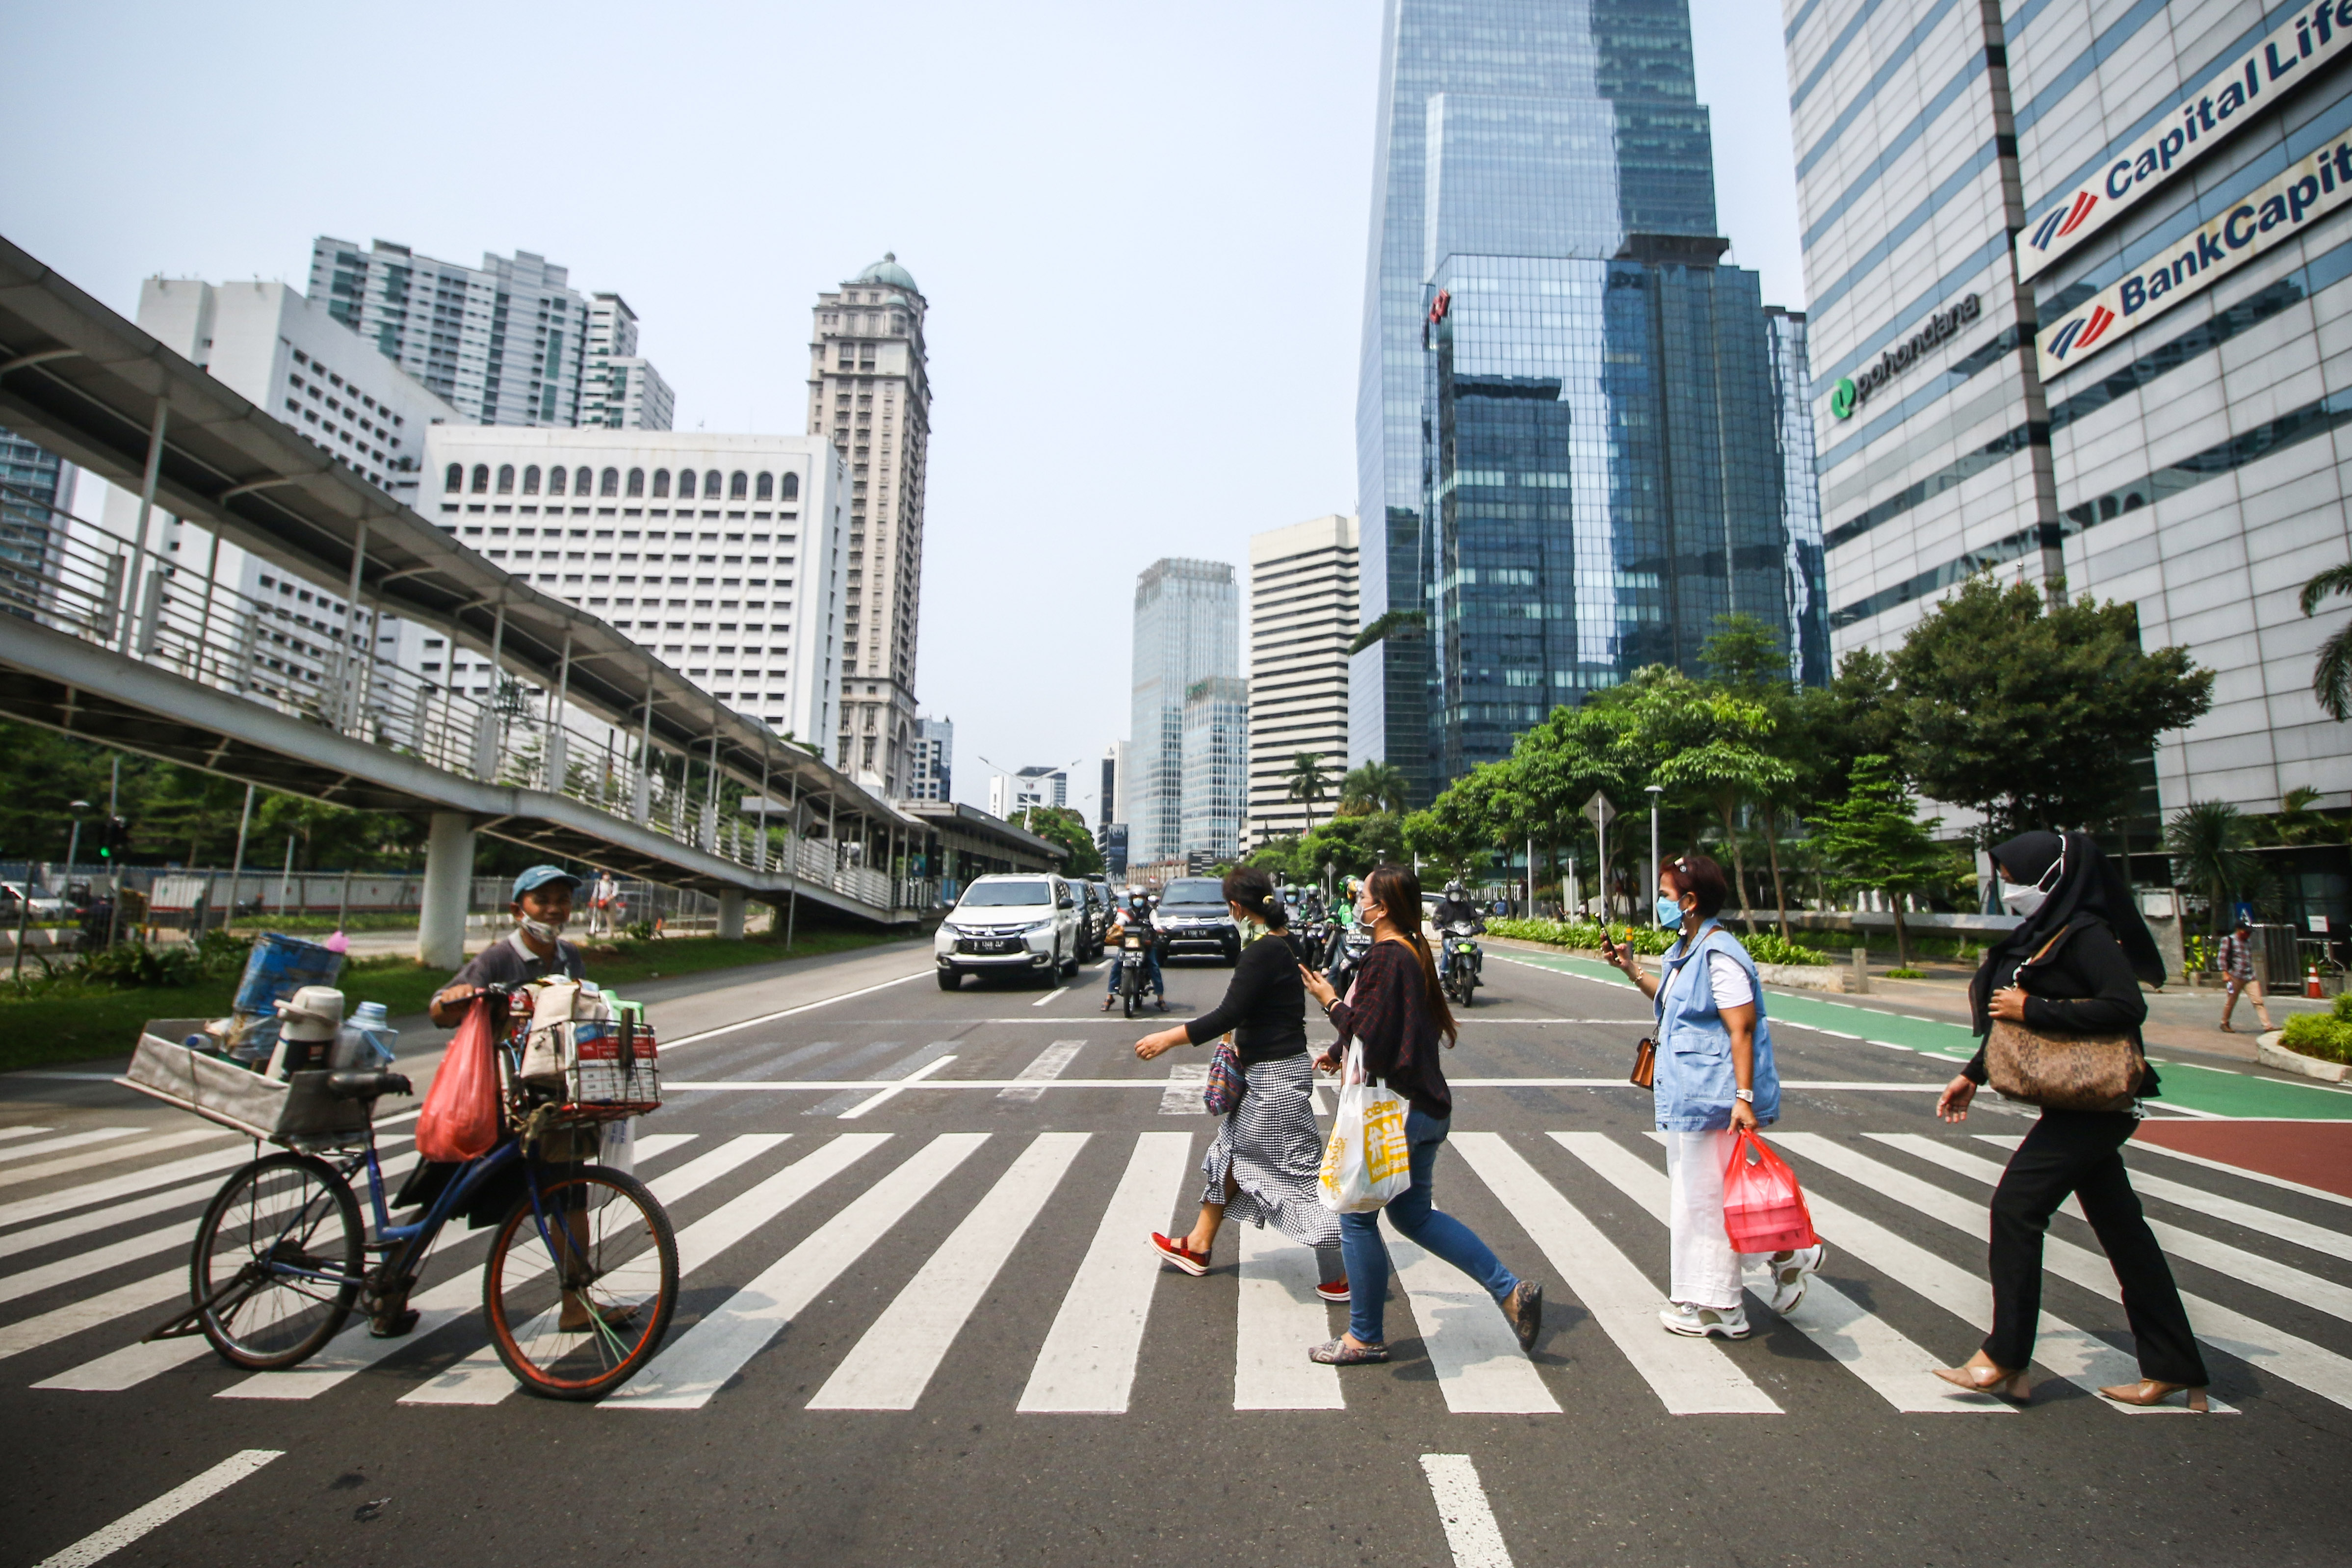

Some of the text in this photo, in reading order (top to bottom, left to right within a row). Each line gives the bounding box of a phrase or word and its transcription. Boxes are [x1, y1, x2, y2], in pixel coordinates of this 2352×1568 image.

[2106, 0, 2352, 200] Capital Life
[2120, 141, 2352, 317] BankCapit
[1856, 293, 1980, 402] pohondana
